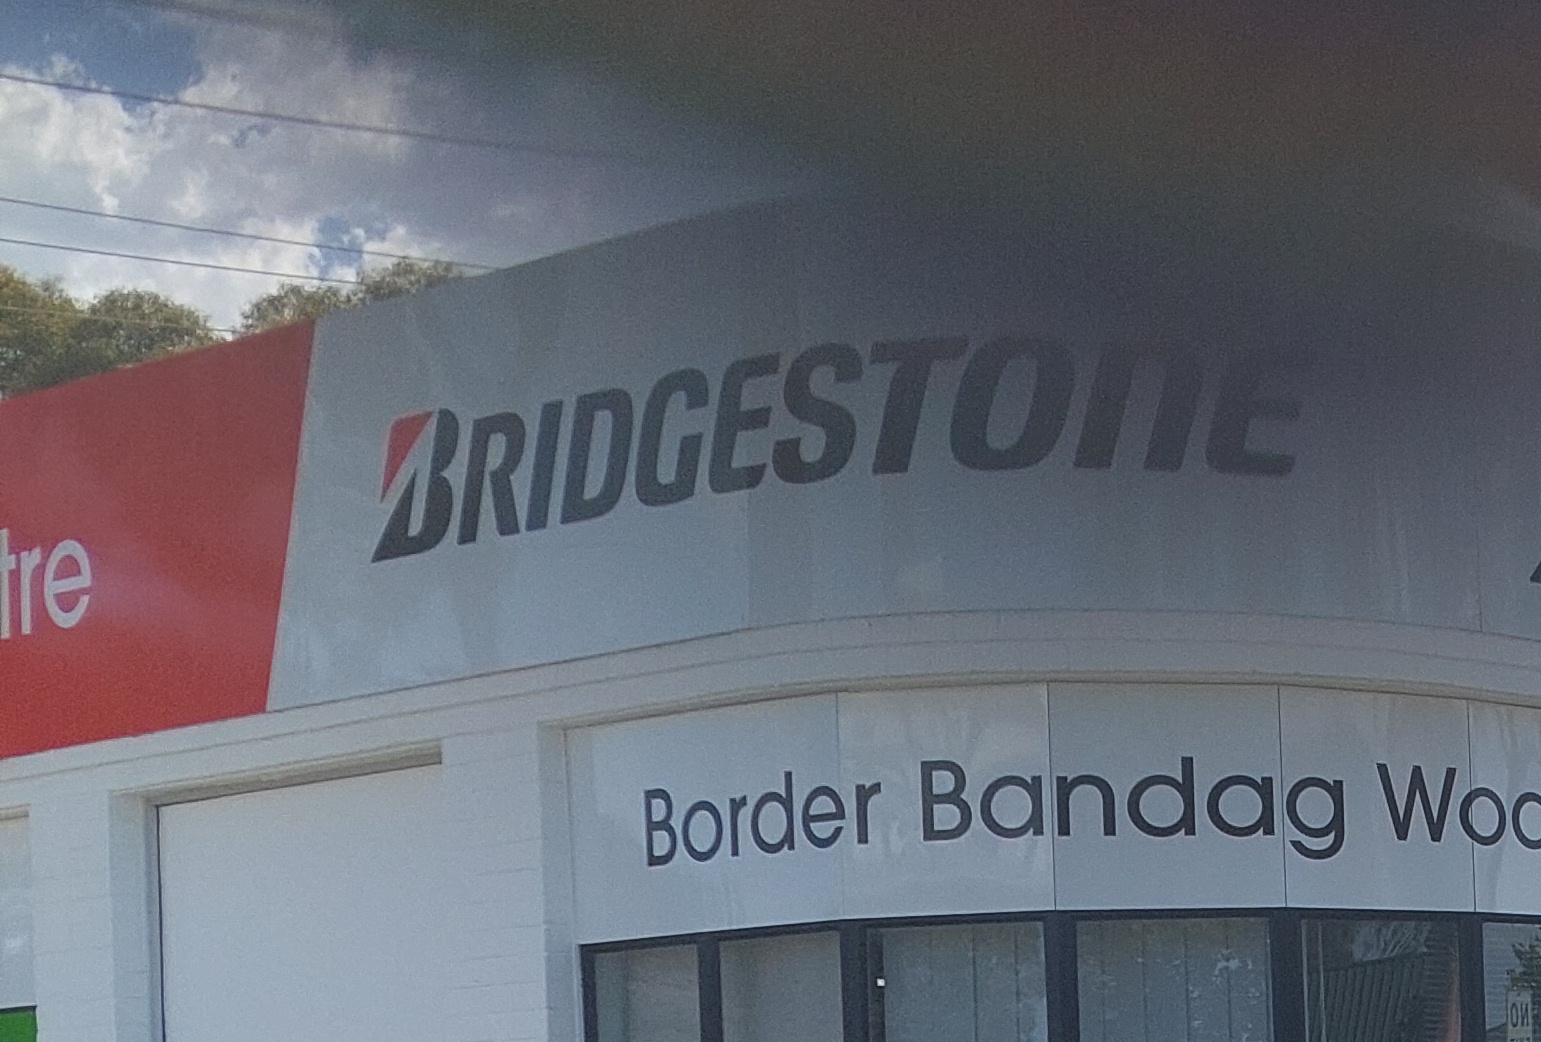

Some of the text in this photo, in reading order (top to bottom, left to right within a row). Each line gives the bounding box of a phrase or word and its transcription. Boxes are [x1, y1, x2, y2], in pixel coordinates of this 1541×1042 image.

[371, 336, 1300, 564] BRIDGESTONE
[644, 772, 881, 868] Border
[919, 756, 1345, 860] Bandag
